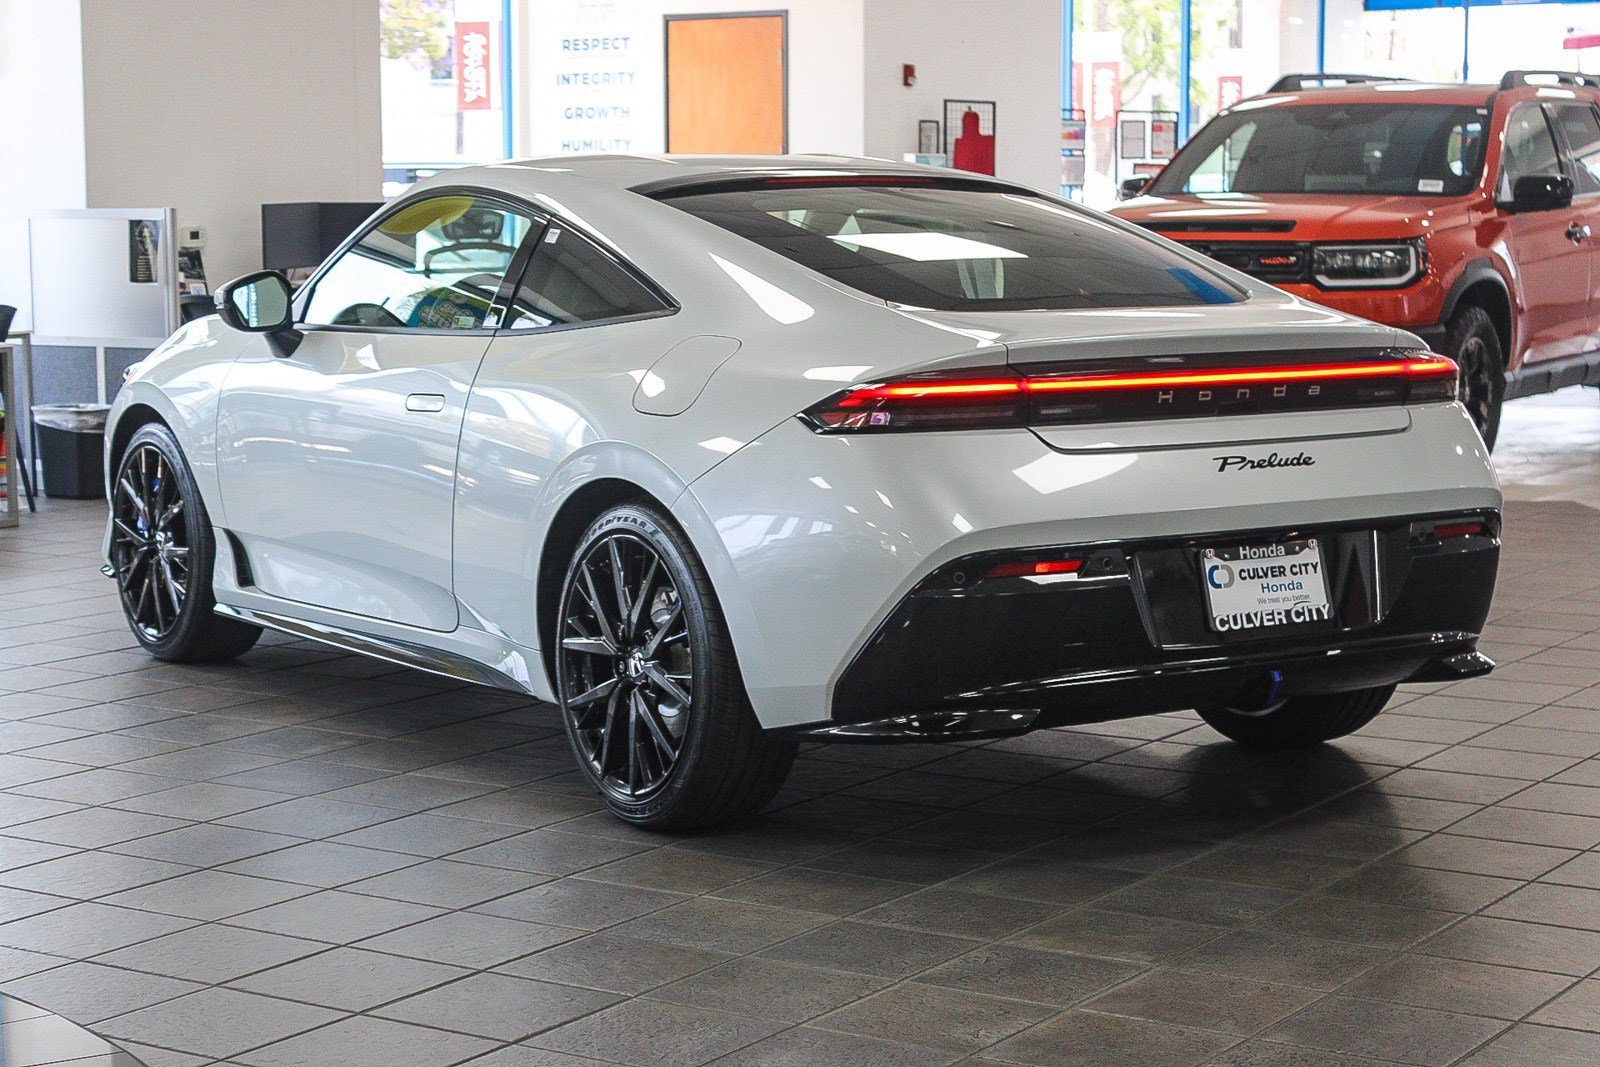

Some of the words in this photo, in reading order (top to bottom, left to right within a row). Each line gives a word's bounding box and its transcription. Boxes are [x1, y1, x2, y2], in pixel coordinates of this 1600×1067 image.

[562, 37, 630, 51] RESPECT
[556, 72, 636, 86] INTEGRITY
[564, 106, 631, 120] GROWTH
[561, 139, 632, 152] HUMILITY
[1212, 452, 1316, 472] Prelude
[1239, 544, 1285, 560] Honda
[1238, 566, 1287, 581] CULVER
[1289, 562, 1319, 577] CITY
[1260, 580, 1304, 593] Honda
[1281, 596, 1291, 604] you
[1215, 609, 1288, 632] CULVER
[1291, 603, 1330, 623] CITY
